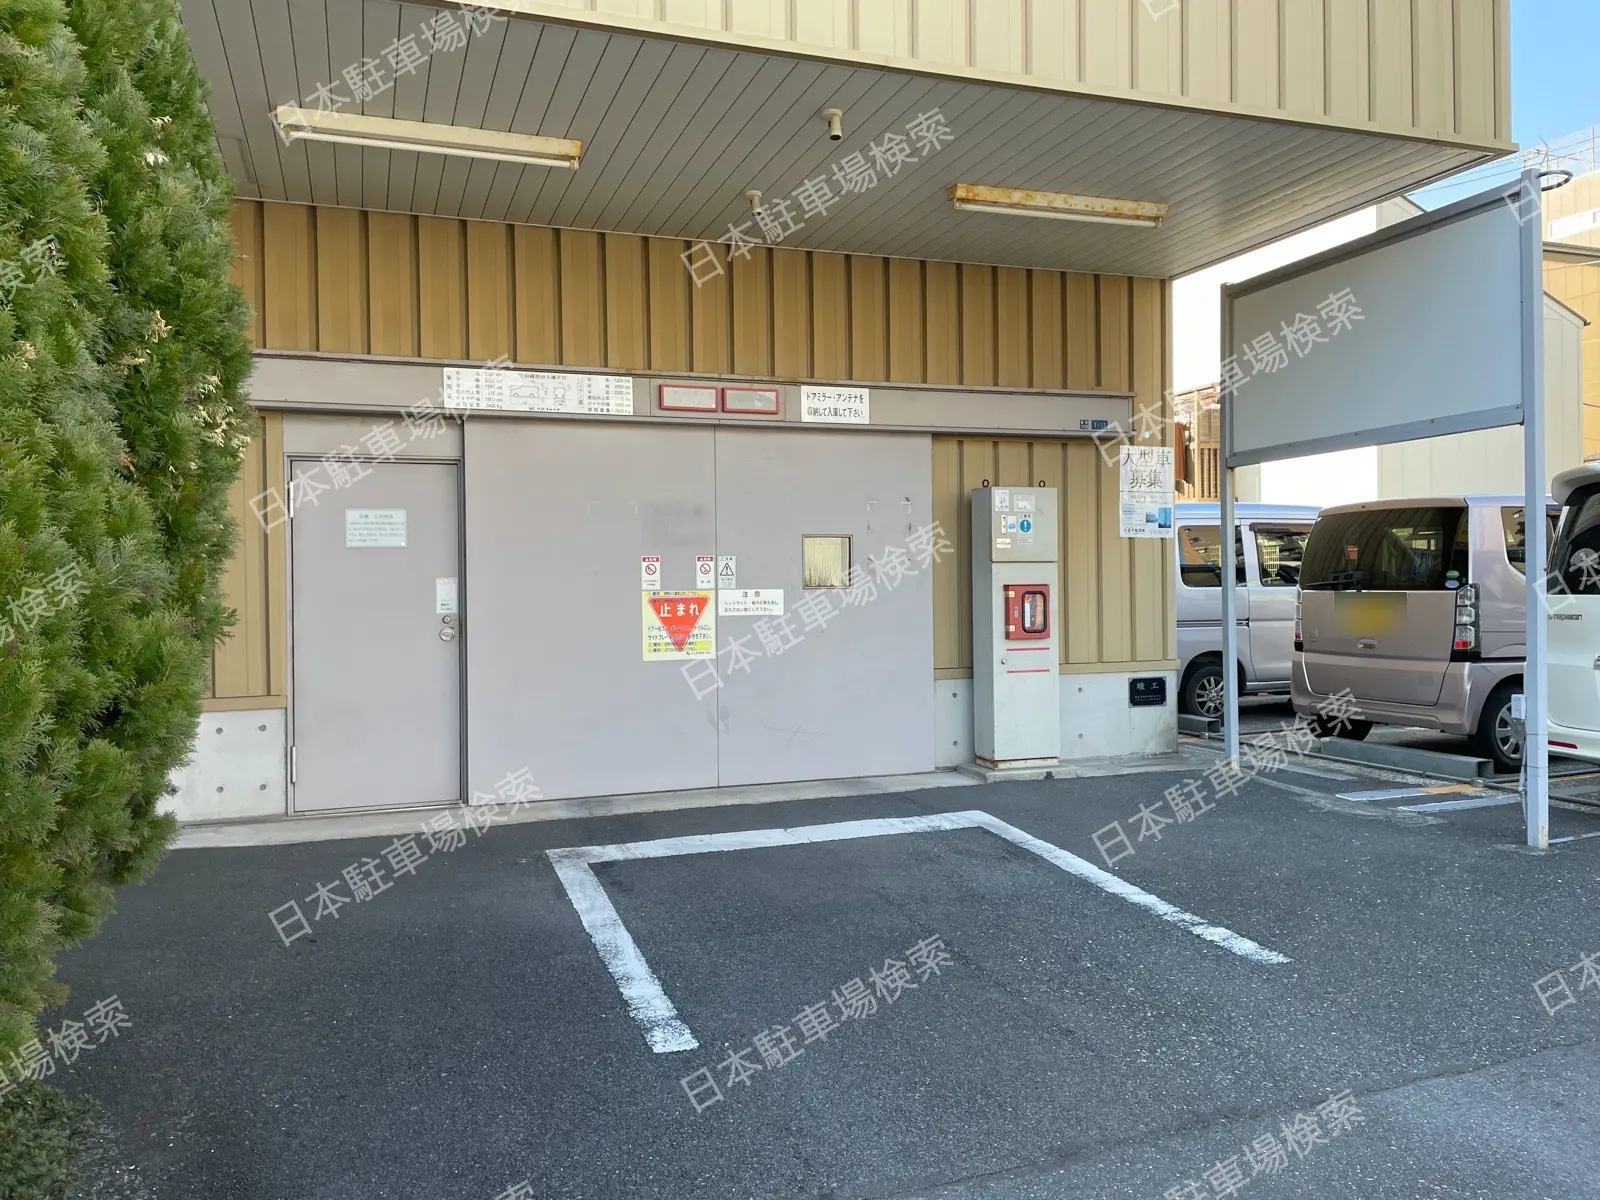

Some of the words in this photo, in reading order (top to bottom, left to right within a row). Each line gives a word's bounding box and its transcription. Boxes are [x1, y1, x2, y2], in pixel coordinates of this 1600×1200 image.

[1121, 448, 1172, 468] 大型車
[1129, 469, 1164, 489] 募集
[660, 603, 700, 617] 止まれ
[1136, 682, 1159, 690] 竣工
